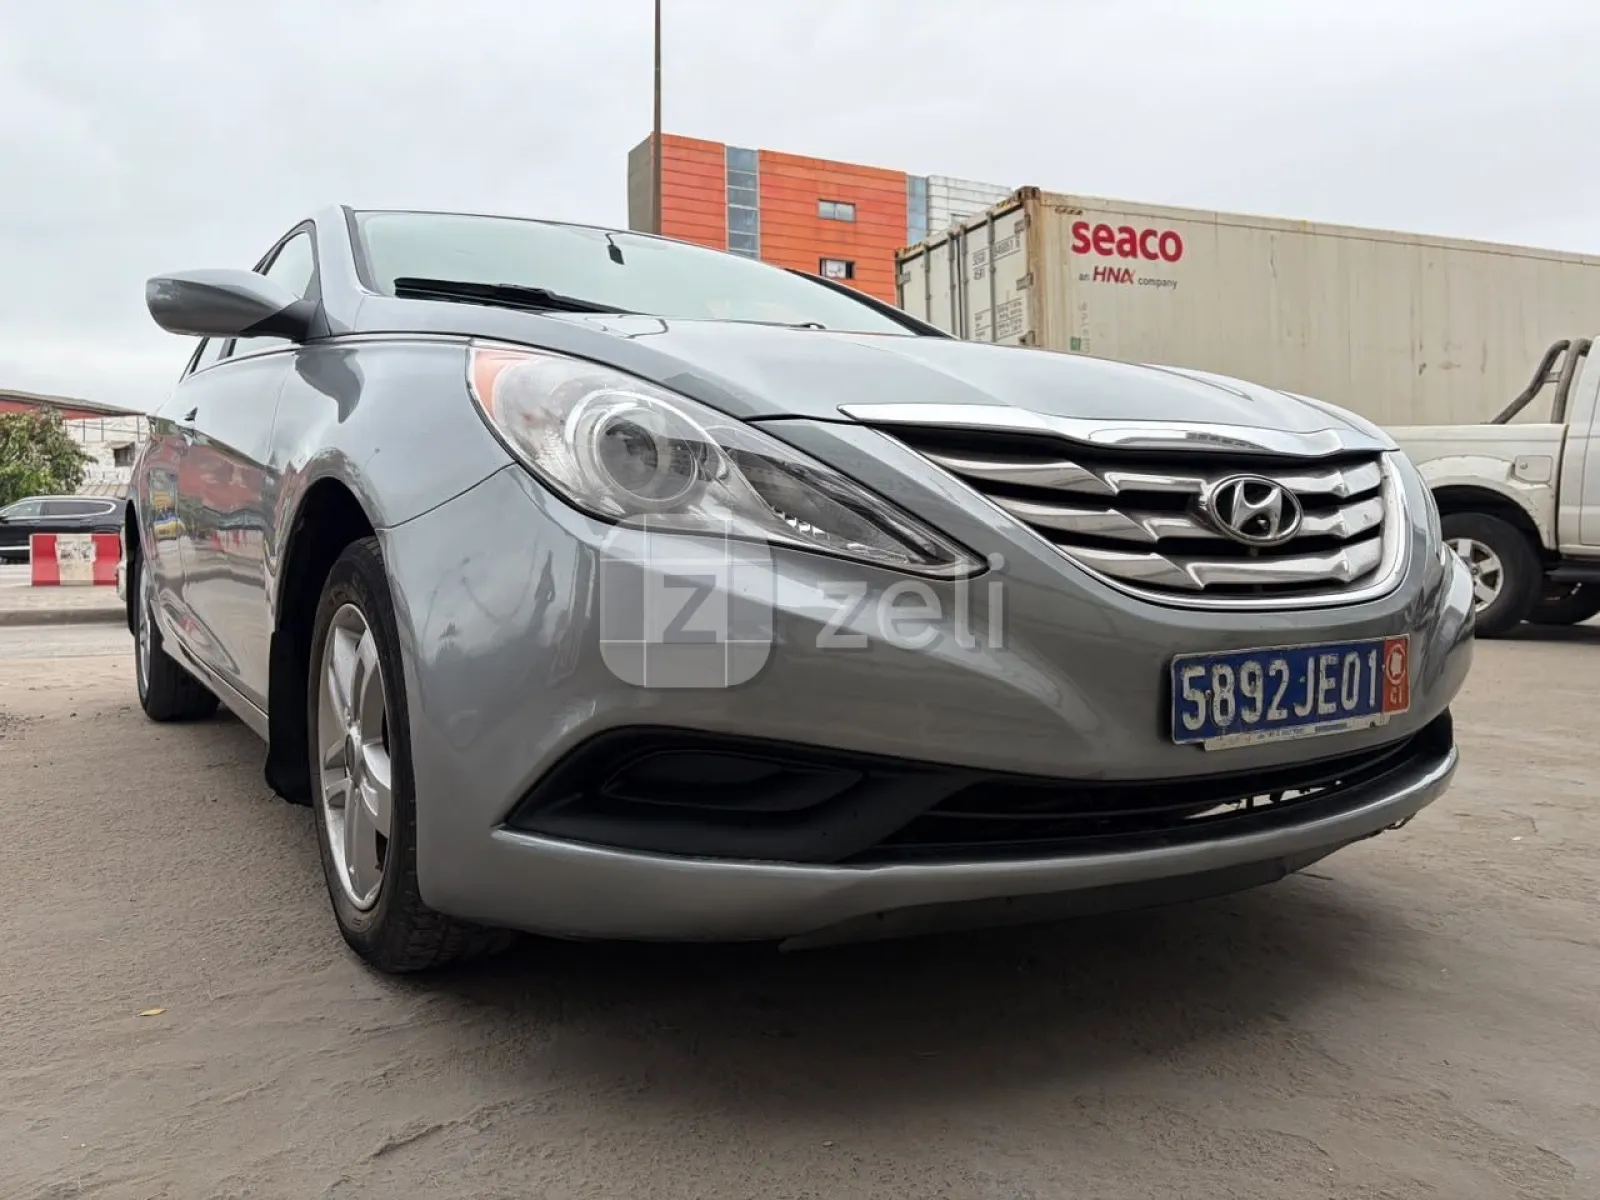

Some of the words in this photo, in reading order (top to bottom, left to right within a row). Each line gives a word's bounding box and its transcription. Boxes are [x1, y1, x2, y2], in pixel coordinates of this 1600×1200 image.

[1071, 220, 1184, 263] seaco
[1092, 265, 1136, 285] HNA
[1137, 277, 1178, 290] company
